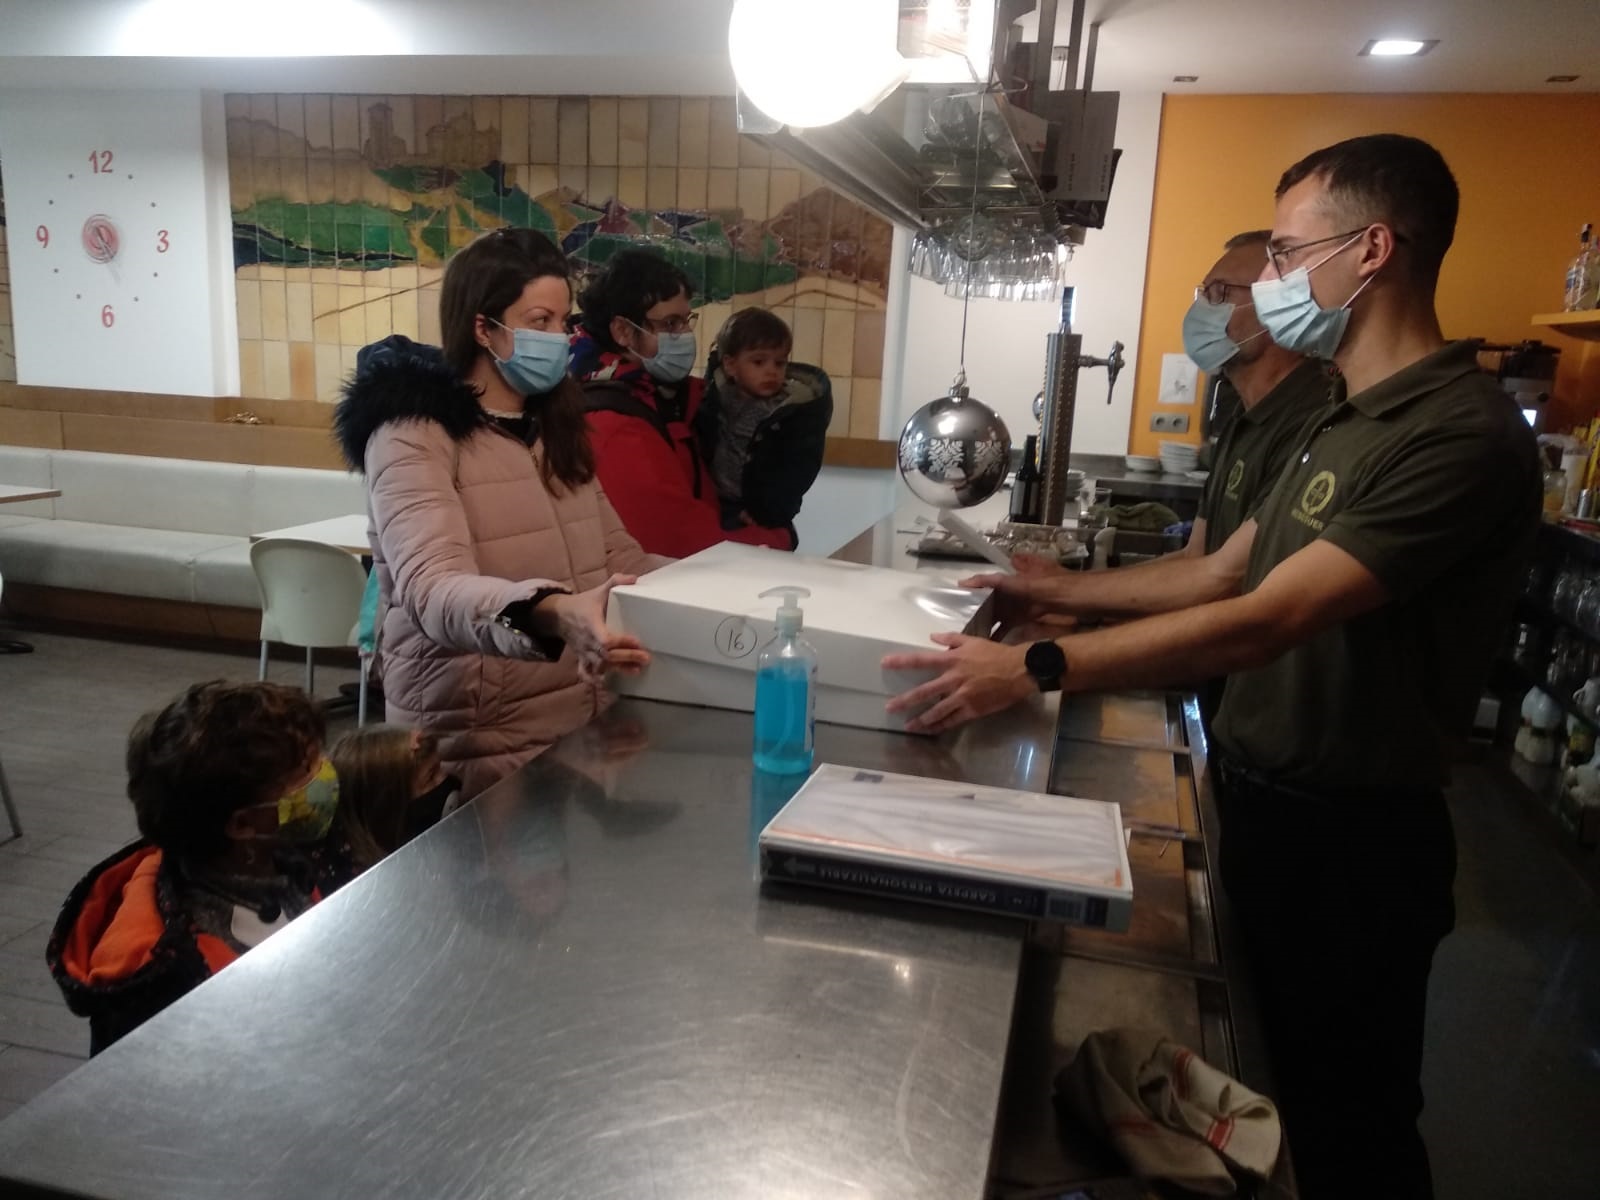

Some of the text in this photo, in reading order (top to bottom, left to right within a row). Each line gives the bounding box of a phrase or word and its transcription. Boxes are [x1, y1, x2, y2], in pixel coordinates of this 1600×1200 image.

[88, 150, 114, 173] 12
[36, 225, 49, 248] 9
[156, 230, 169, 253] 3
[101, 304, 115, 328] 6
[727, 629, 745, 652] 16
[938, 885, 997, 904] CARPETA
